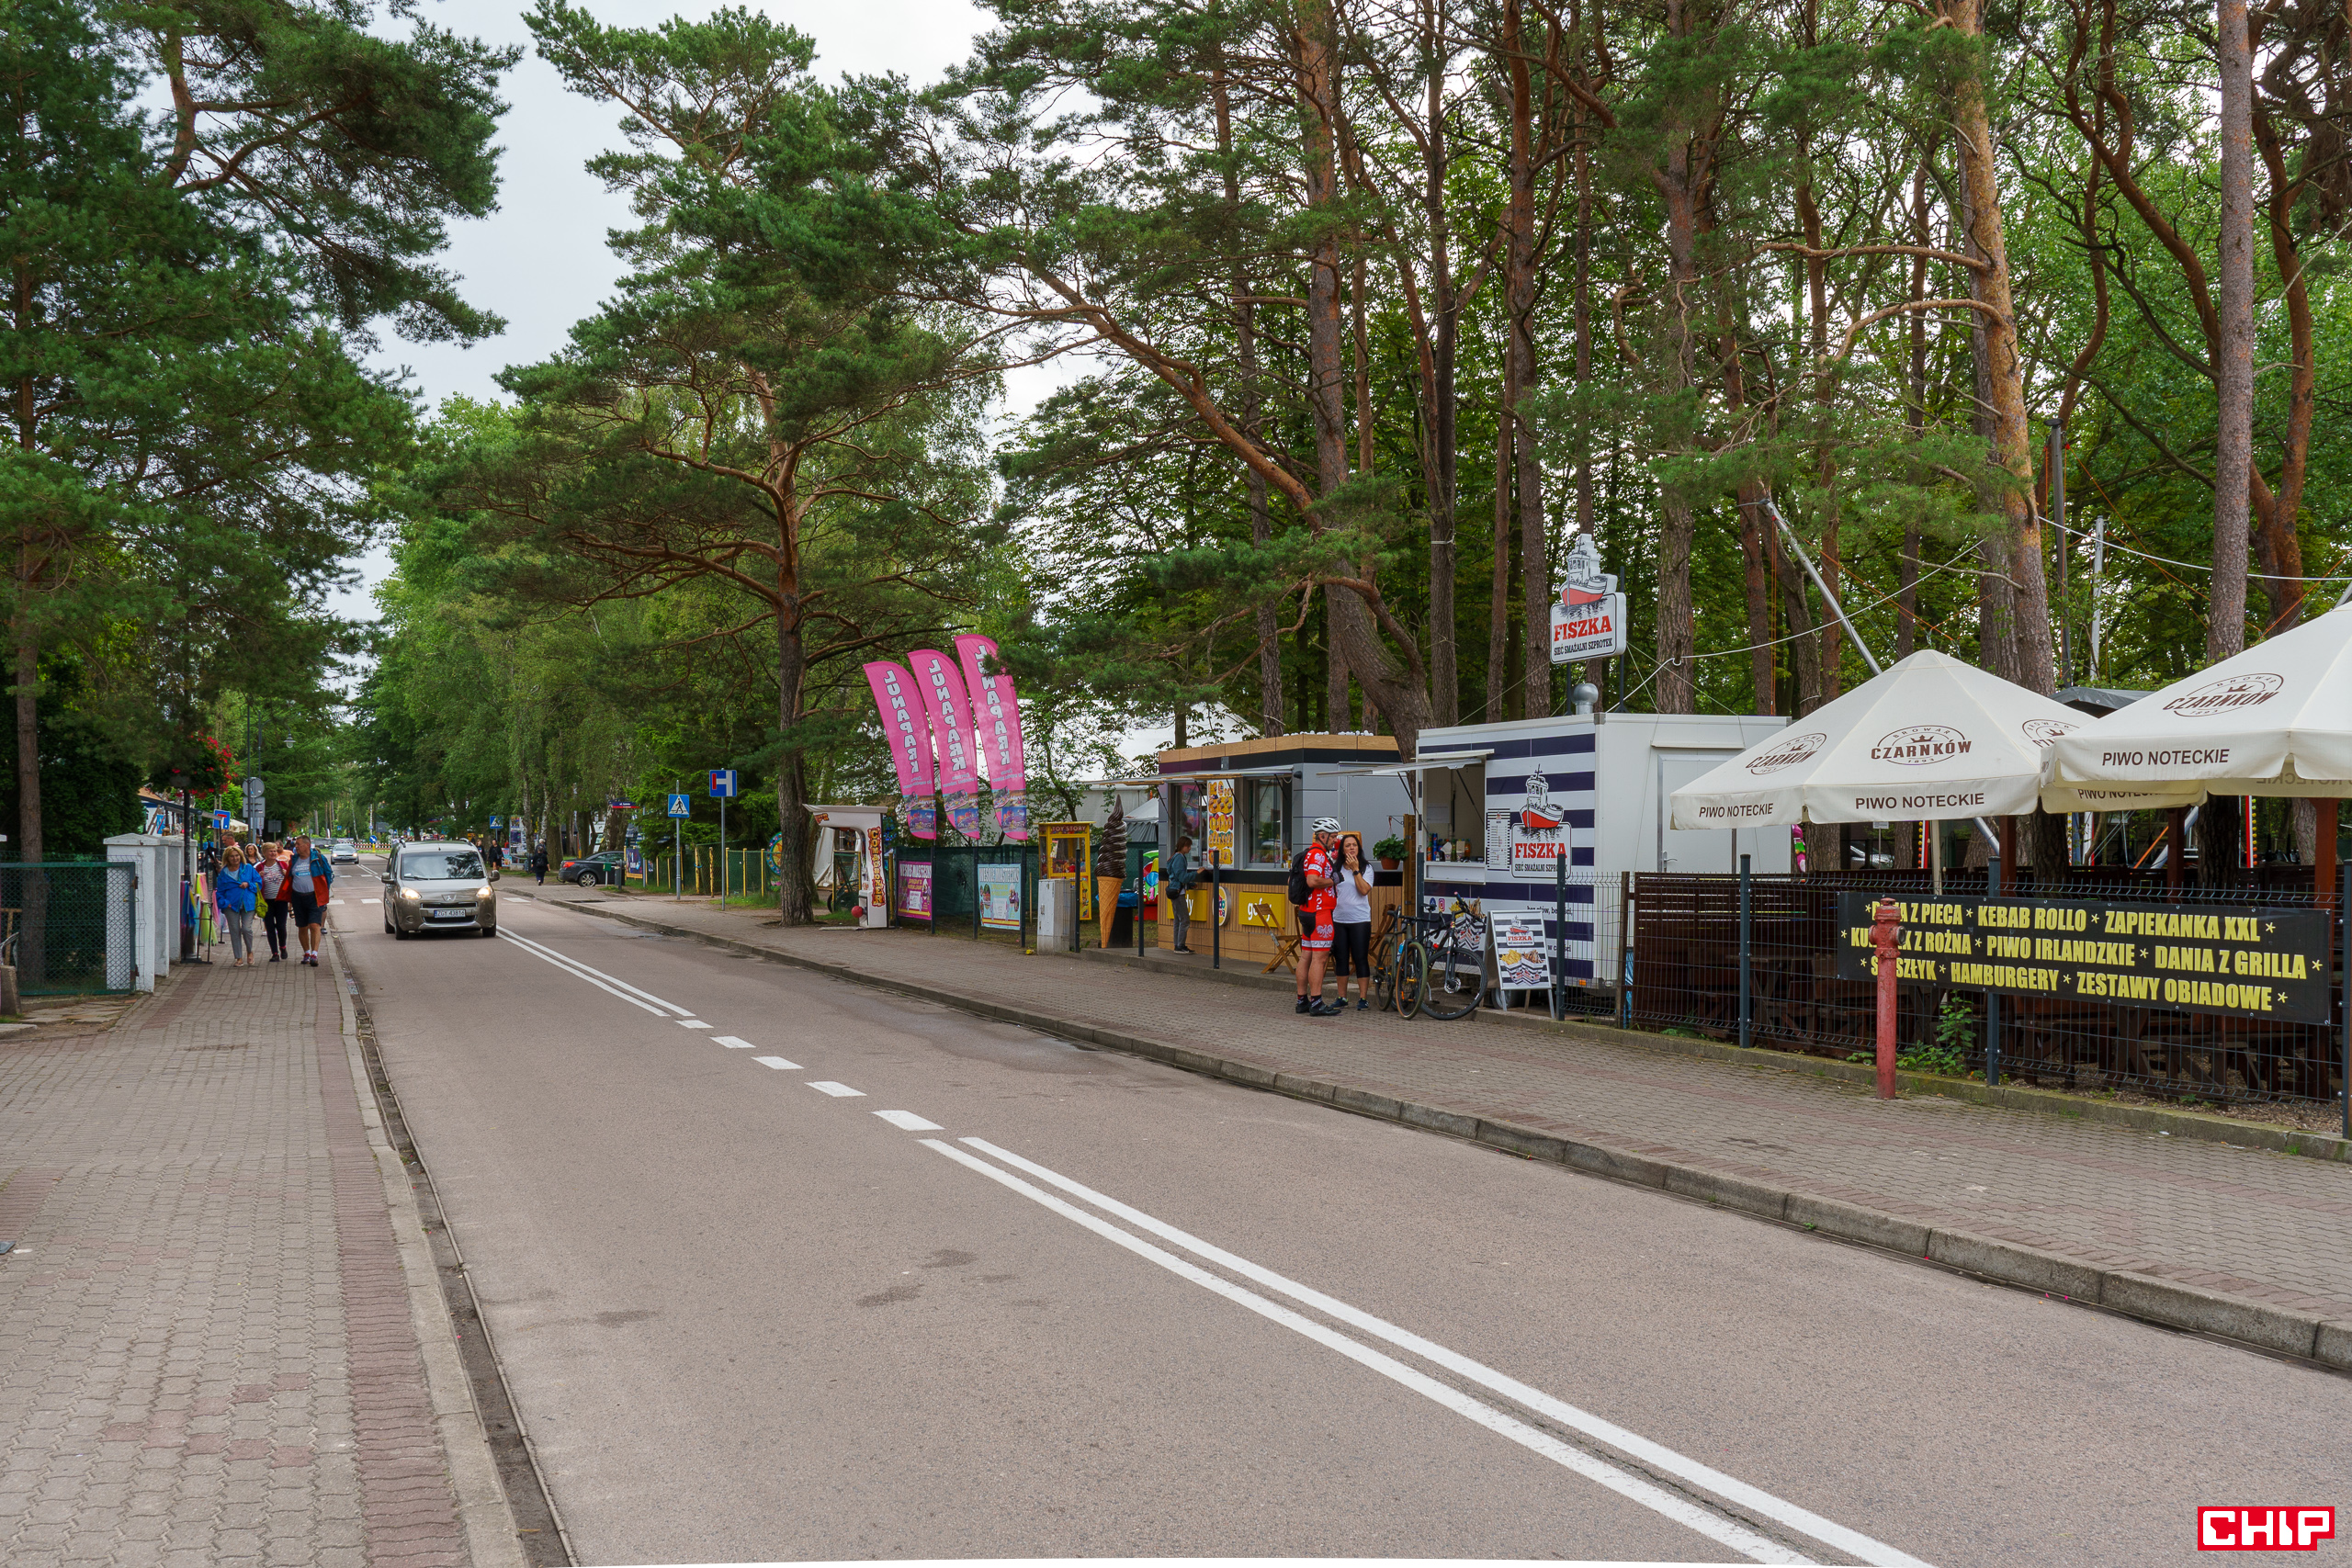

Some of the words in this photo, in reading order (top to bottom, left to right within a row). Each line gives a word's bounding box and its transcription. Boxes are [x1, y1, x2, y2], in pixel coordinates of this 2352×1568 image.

[1554, 615, 1612, 642] FISZKA
[1554, 643, 1564, 656] SIEĆ
[1565, 642, 1588, 654] SMAŻALNI
[1589, 637, 1612, 650] SZPROTEK
[1893, 727, 1951, 739] BROWAR
[1871, 739, 1972, 760] CZARNKÓW
[2102, 751, 2143, 766] PIWO
[2148, 749, 2230, 765] NOTECKIE
[1699, 807, 1724, 818] PIWO
[1727, 803, 1773, 818] NOTECKIE
[1855, 797, 1897, 809] PIWO
[1902, 793, 1984, 808] NOTECKIE
[1515, 842, 1567, 859] FISZKA
[1911, 903, 1918, 922] Z
[1921, 904, 1963, 925] PIECA
[1978, 906, 2030, 929] KEBAB
[2034, 908, 2086, 931] ROLLO
[2105, 910, 2220, 940] ZAPIEKANKA
[2224, 917, 2260, 942] XXL
[1915, 931, 1922, 951] Z
[1926, 929, 1972, 955] ROŻNA
[1987, 935, 2031, 959] PIWO
[2035, 938, 2135, 966] IRLANDZKIE
[2154, 945, 2215, 973] DANIA
[2219, 950, 2230, 974] Z
[2234, 951, 2307, 980] GRILLA
[1871, 955, 1937, 981] SSZŁYK
[1951, 962, 2060, 991] HAMBURGERY
[2077, 972, 2160, 1000] ZESTAWY
[2165, 978, 2273, 1011] OBIADOWE
